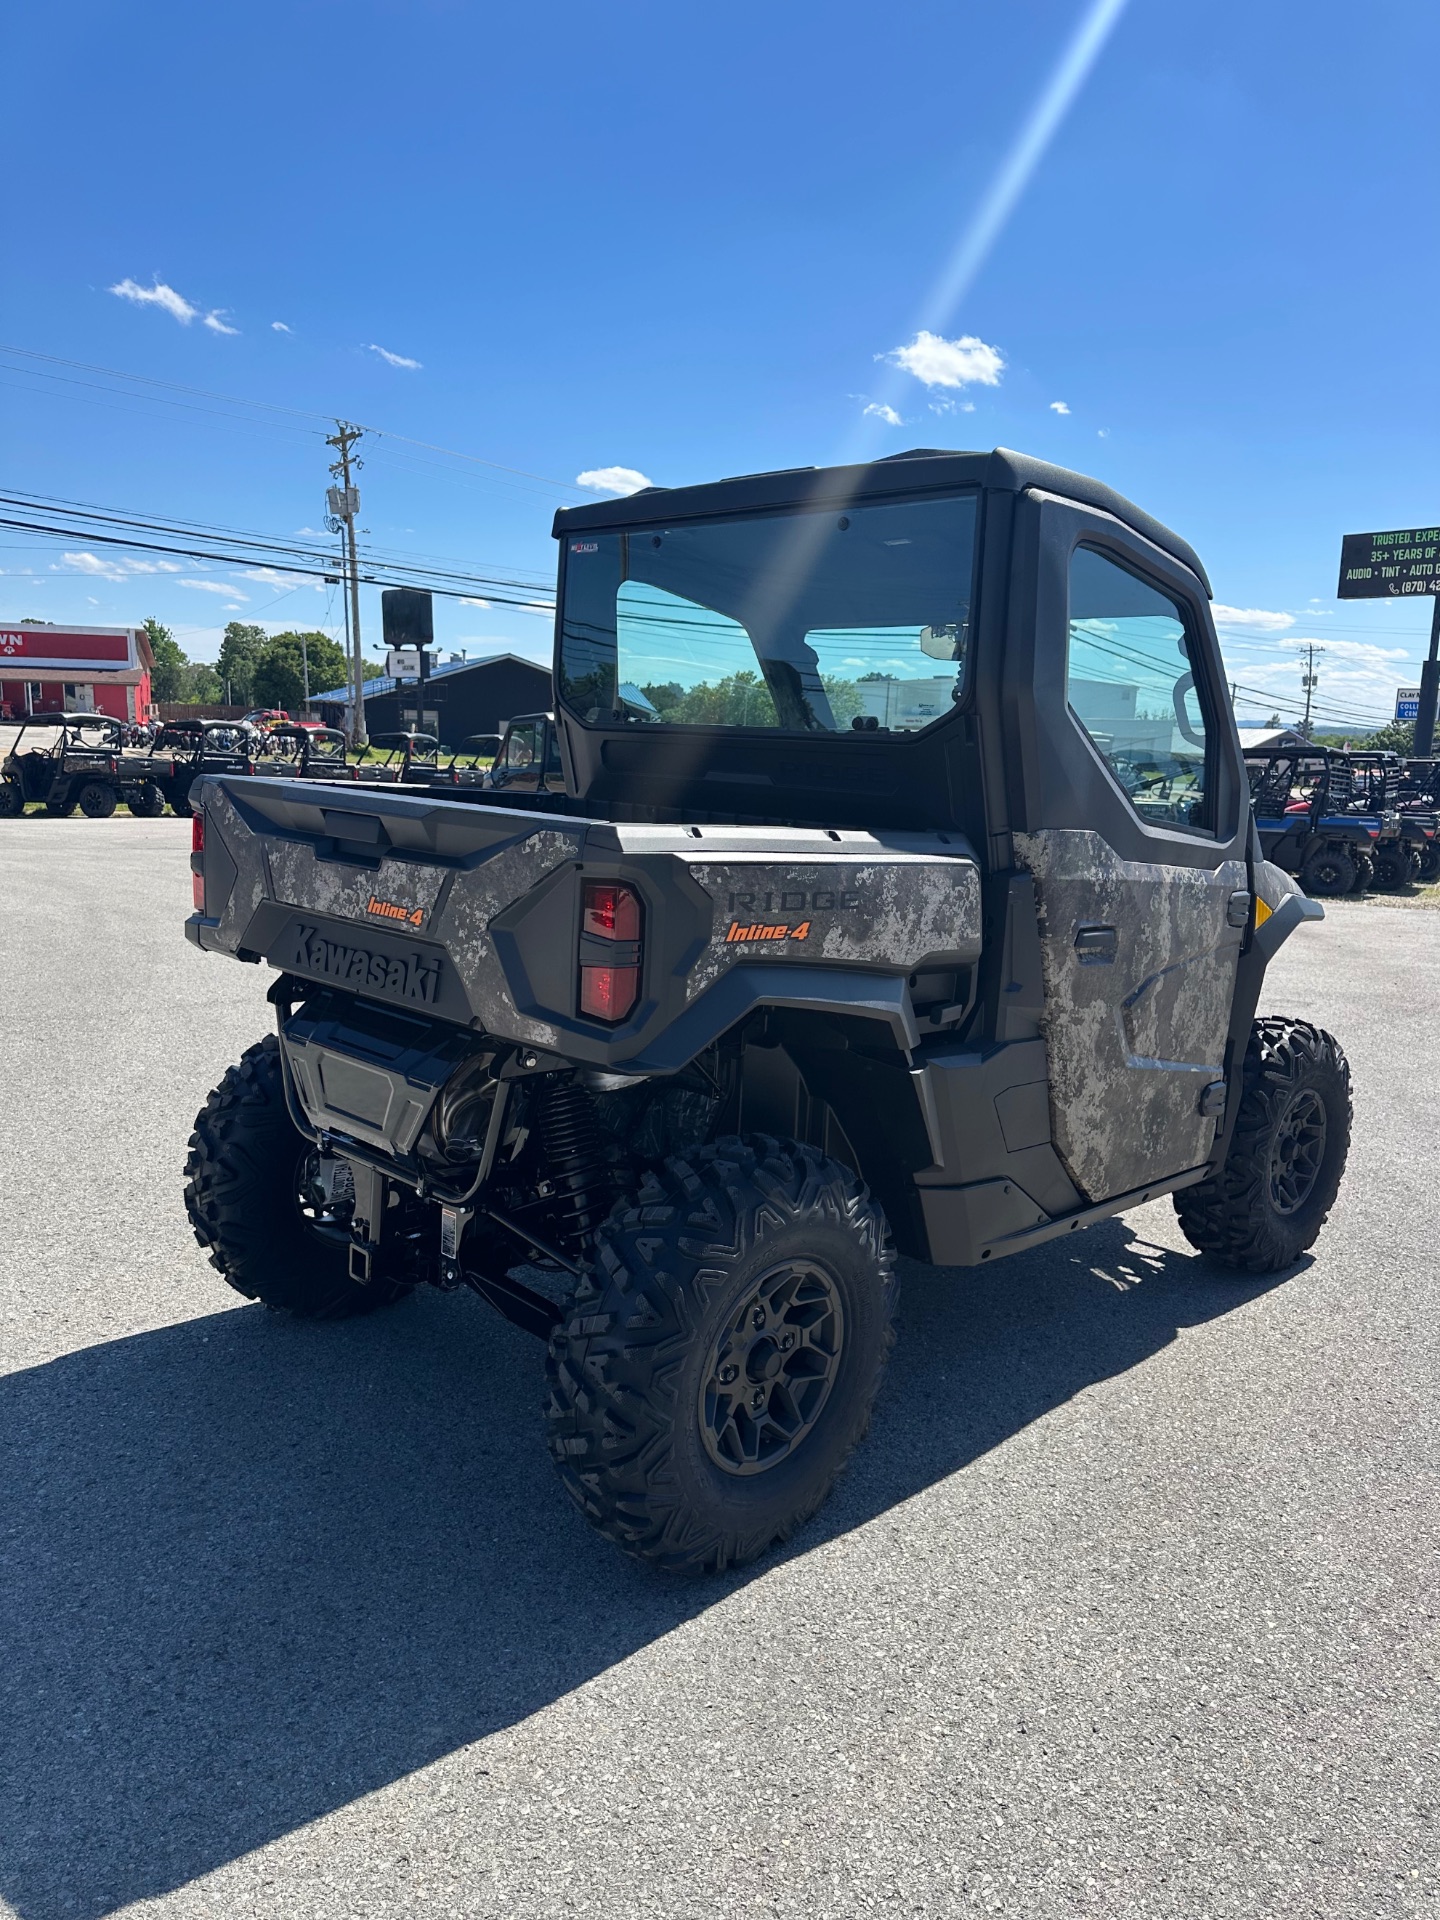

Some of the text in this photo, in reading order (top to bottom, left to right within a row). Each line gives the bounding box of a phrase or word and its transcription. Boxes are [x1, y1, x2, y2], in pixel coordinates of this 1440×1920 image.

[1372, 529, 1440, 546] TRUSTED. EXPE
[1370, 550, 1390, 562] 35+
[1393, 548, 1423, 561] YEARS
[1424, 547, 1437, 559] OF
[1346, 567, 1372, 580] AUDIO
[1381, 565, 1400, 578] TINT
[1409, 563, 1433, 576] AUTO
[1401, 580, 1426, 593] (870)
[367, 895, 425, 927] Inline-4
[728, 890, 860, 913] RIDGE
[725, 920, 812, 943] Inline-4
[291, 922, 444, 1004] Kawasaki
